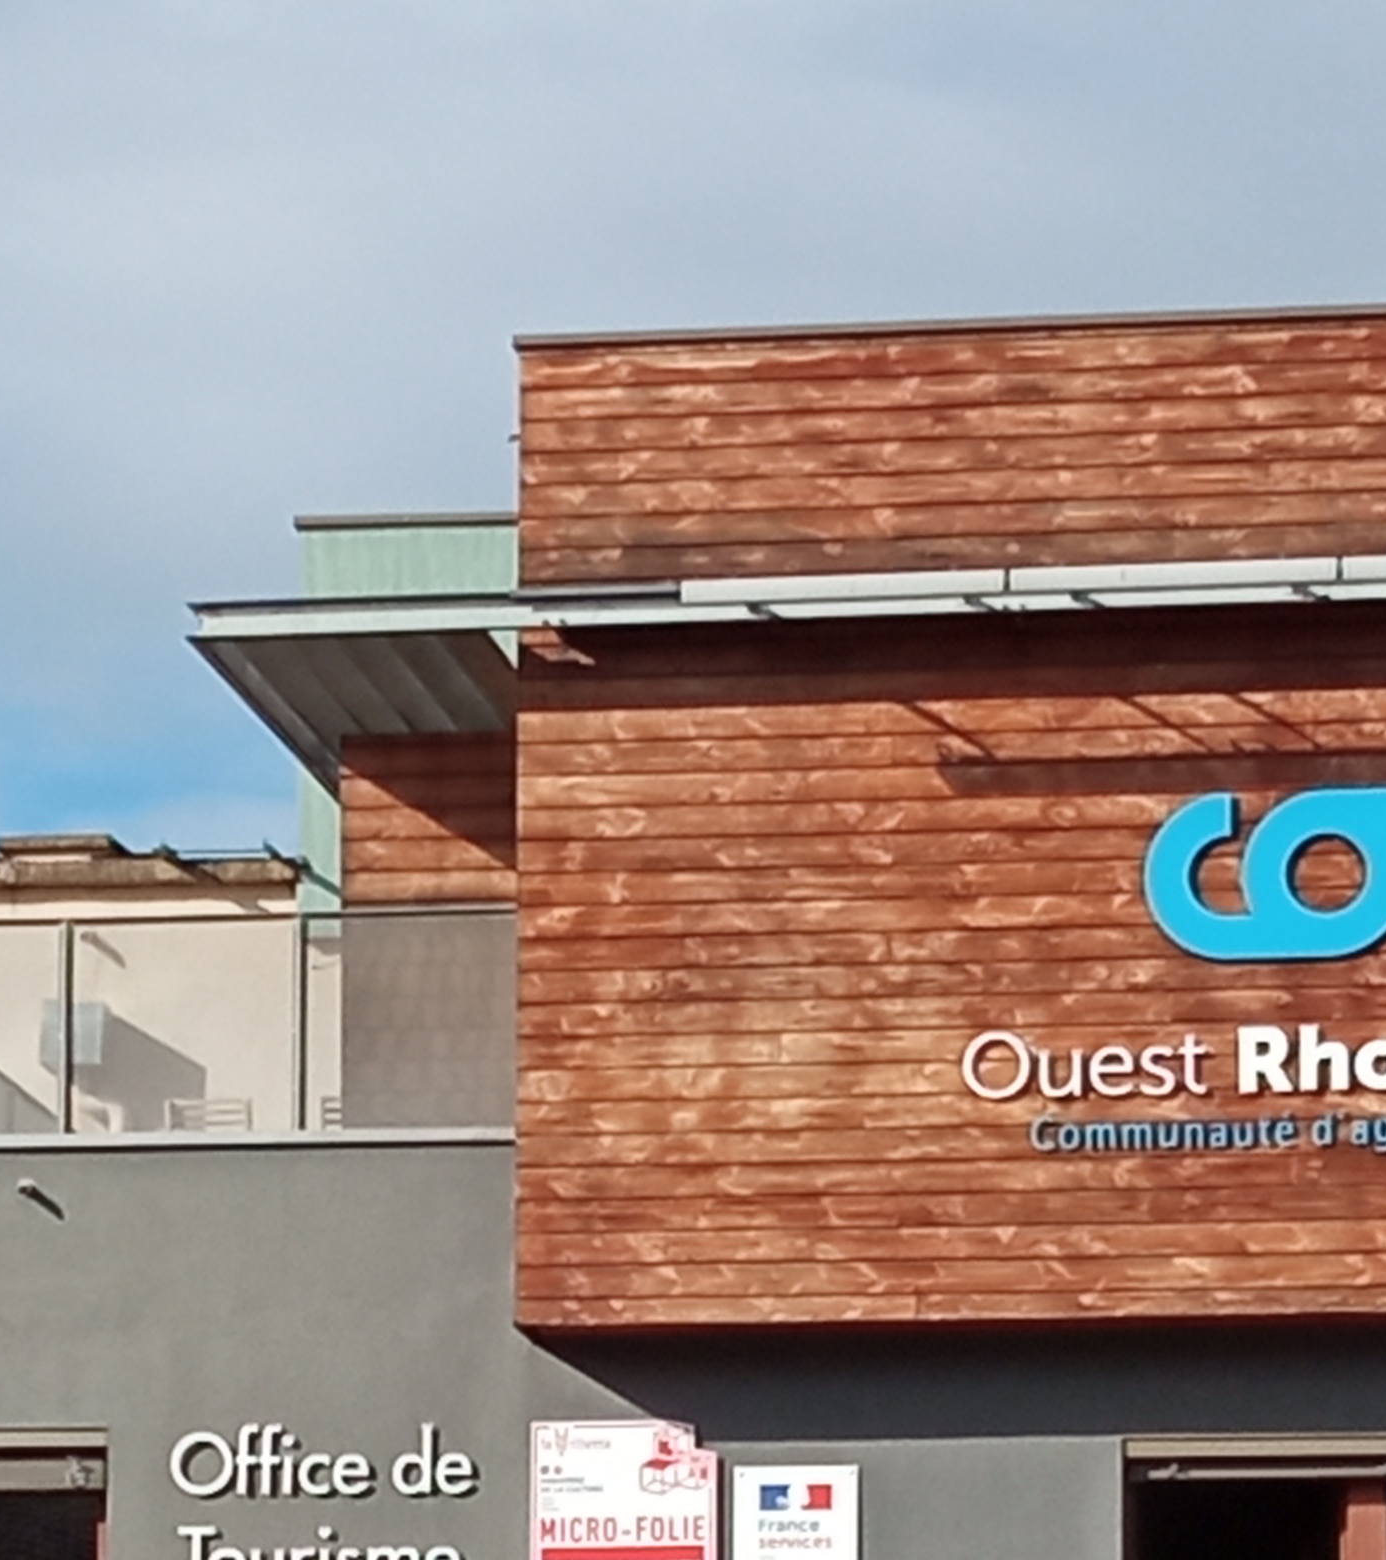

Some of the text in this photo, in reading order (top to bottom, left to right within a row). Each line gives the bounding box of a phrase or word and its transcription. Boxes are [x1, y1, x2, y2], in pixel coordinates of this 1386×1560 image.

[961, 1030, 1209, 1099] Ouest
[1029, 1112, 1297, 1153] Communauté
[170, 1422, 371, 1497] Office
[391, 1422, 476, 1496] de
[540, 1515, 705, 1543] MICRO-FOLIE
[758, 1518, 819, 1532] France
[758, 1535, 832, 1550] services
